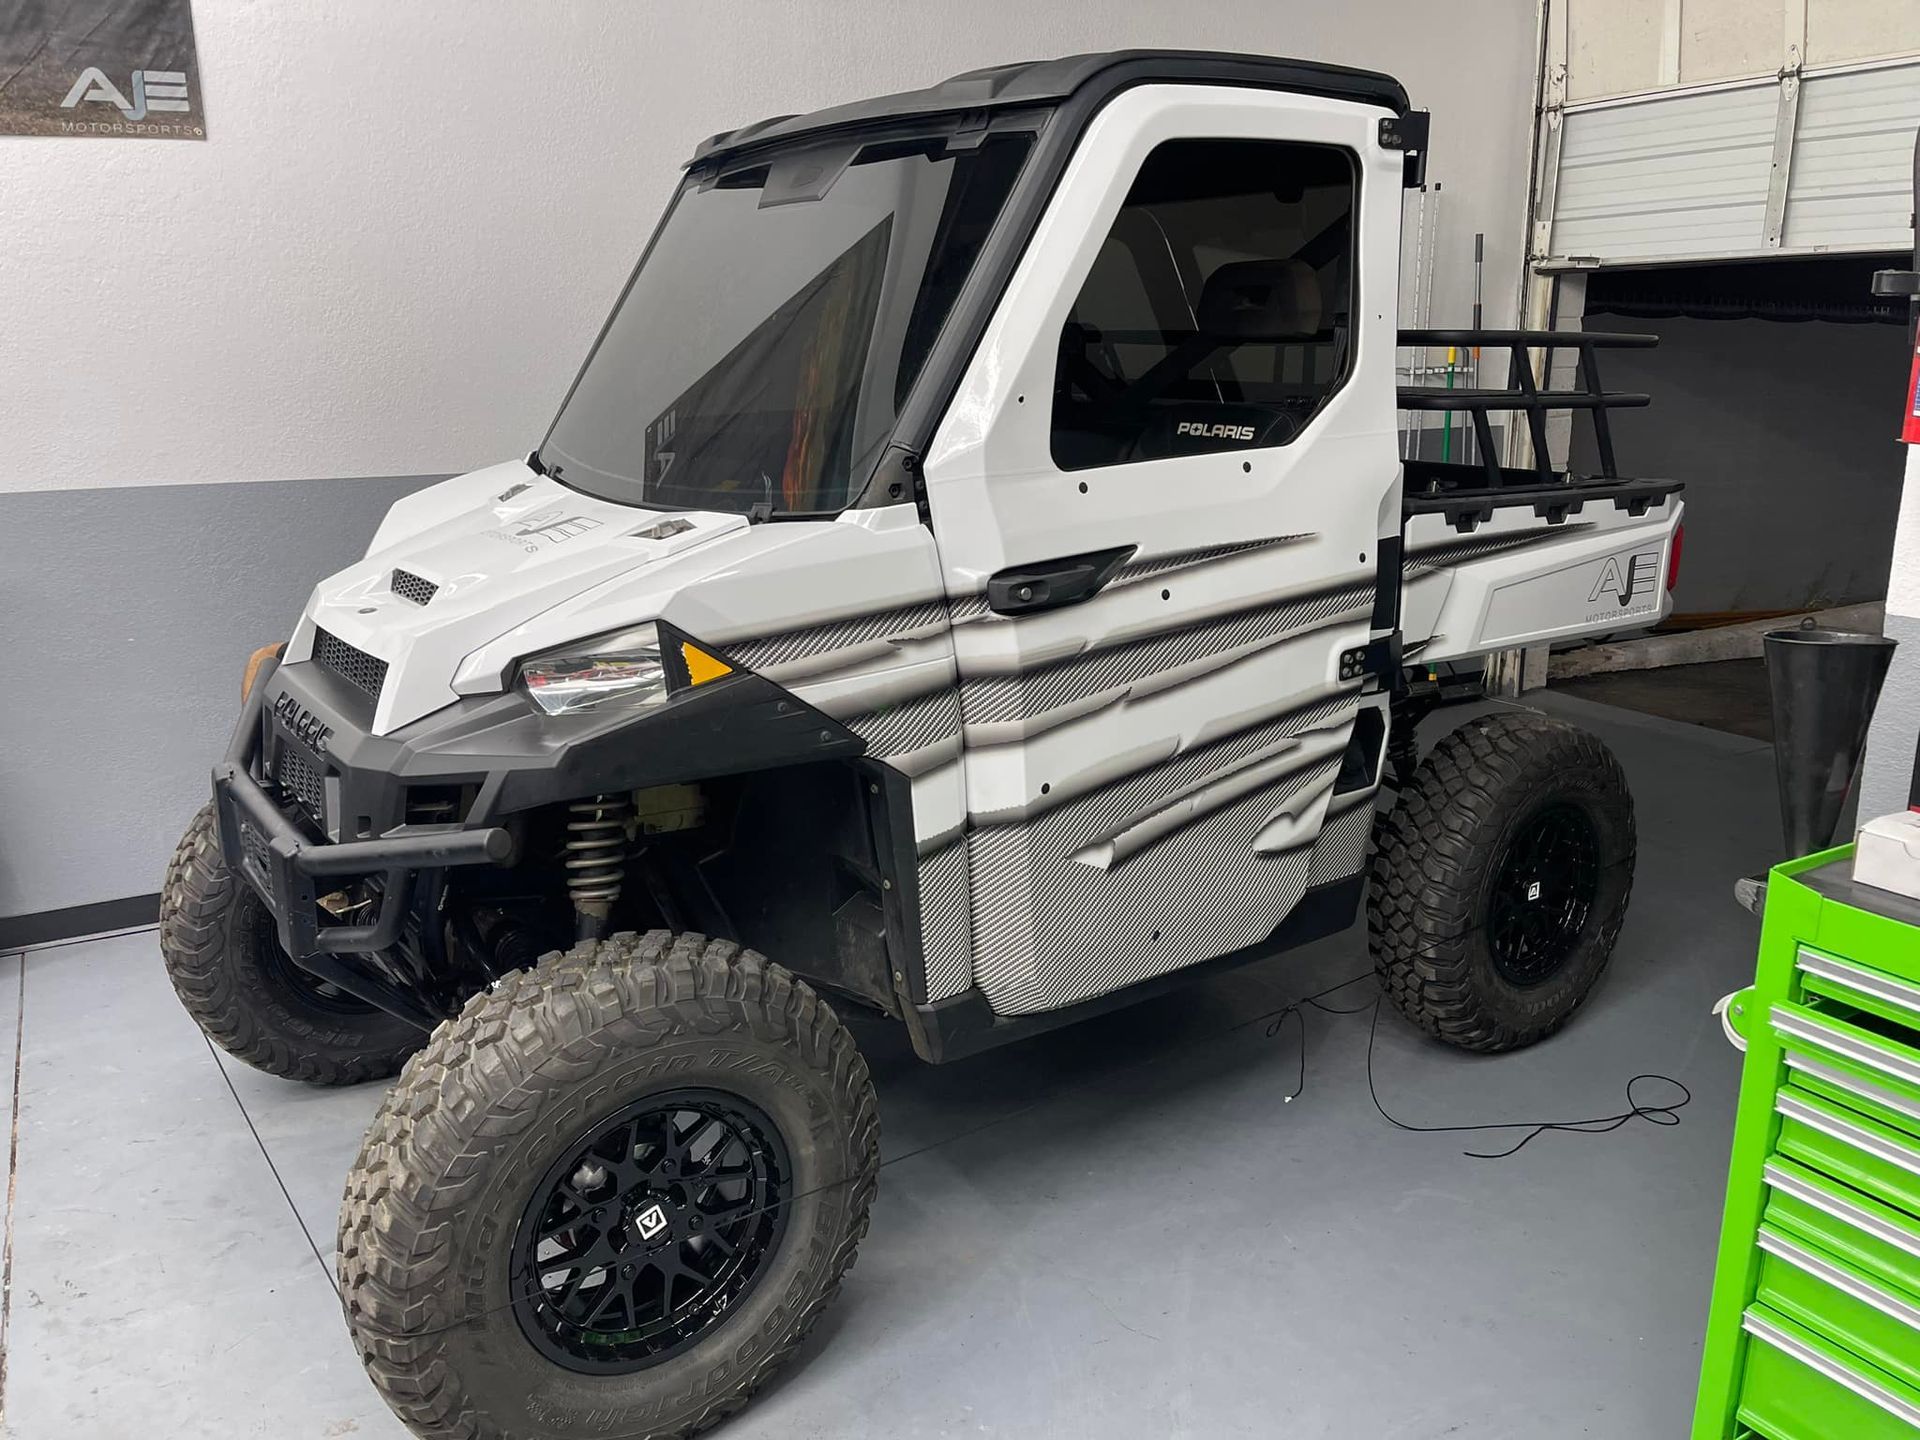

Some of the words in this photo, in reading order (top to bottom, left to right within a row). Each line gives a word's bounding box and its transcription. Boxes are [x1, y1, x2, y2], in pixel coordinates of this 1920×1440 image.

[60, 67, 190, 120] AJE
[61, 121, 194, 136] MOTORSPORTS
[1177, 422, 1255, 440] POLARIS
[1587, 552, 1659, 607] AJE
[1585, 603, 1653, 623] MOTORSPORTS
